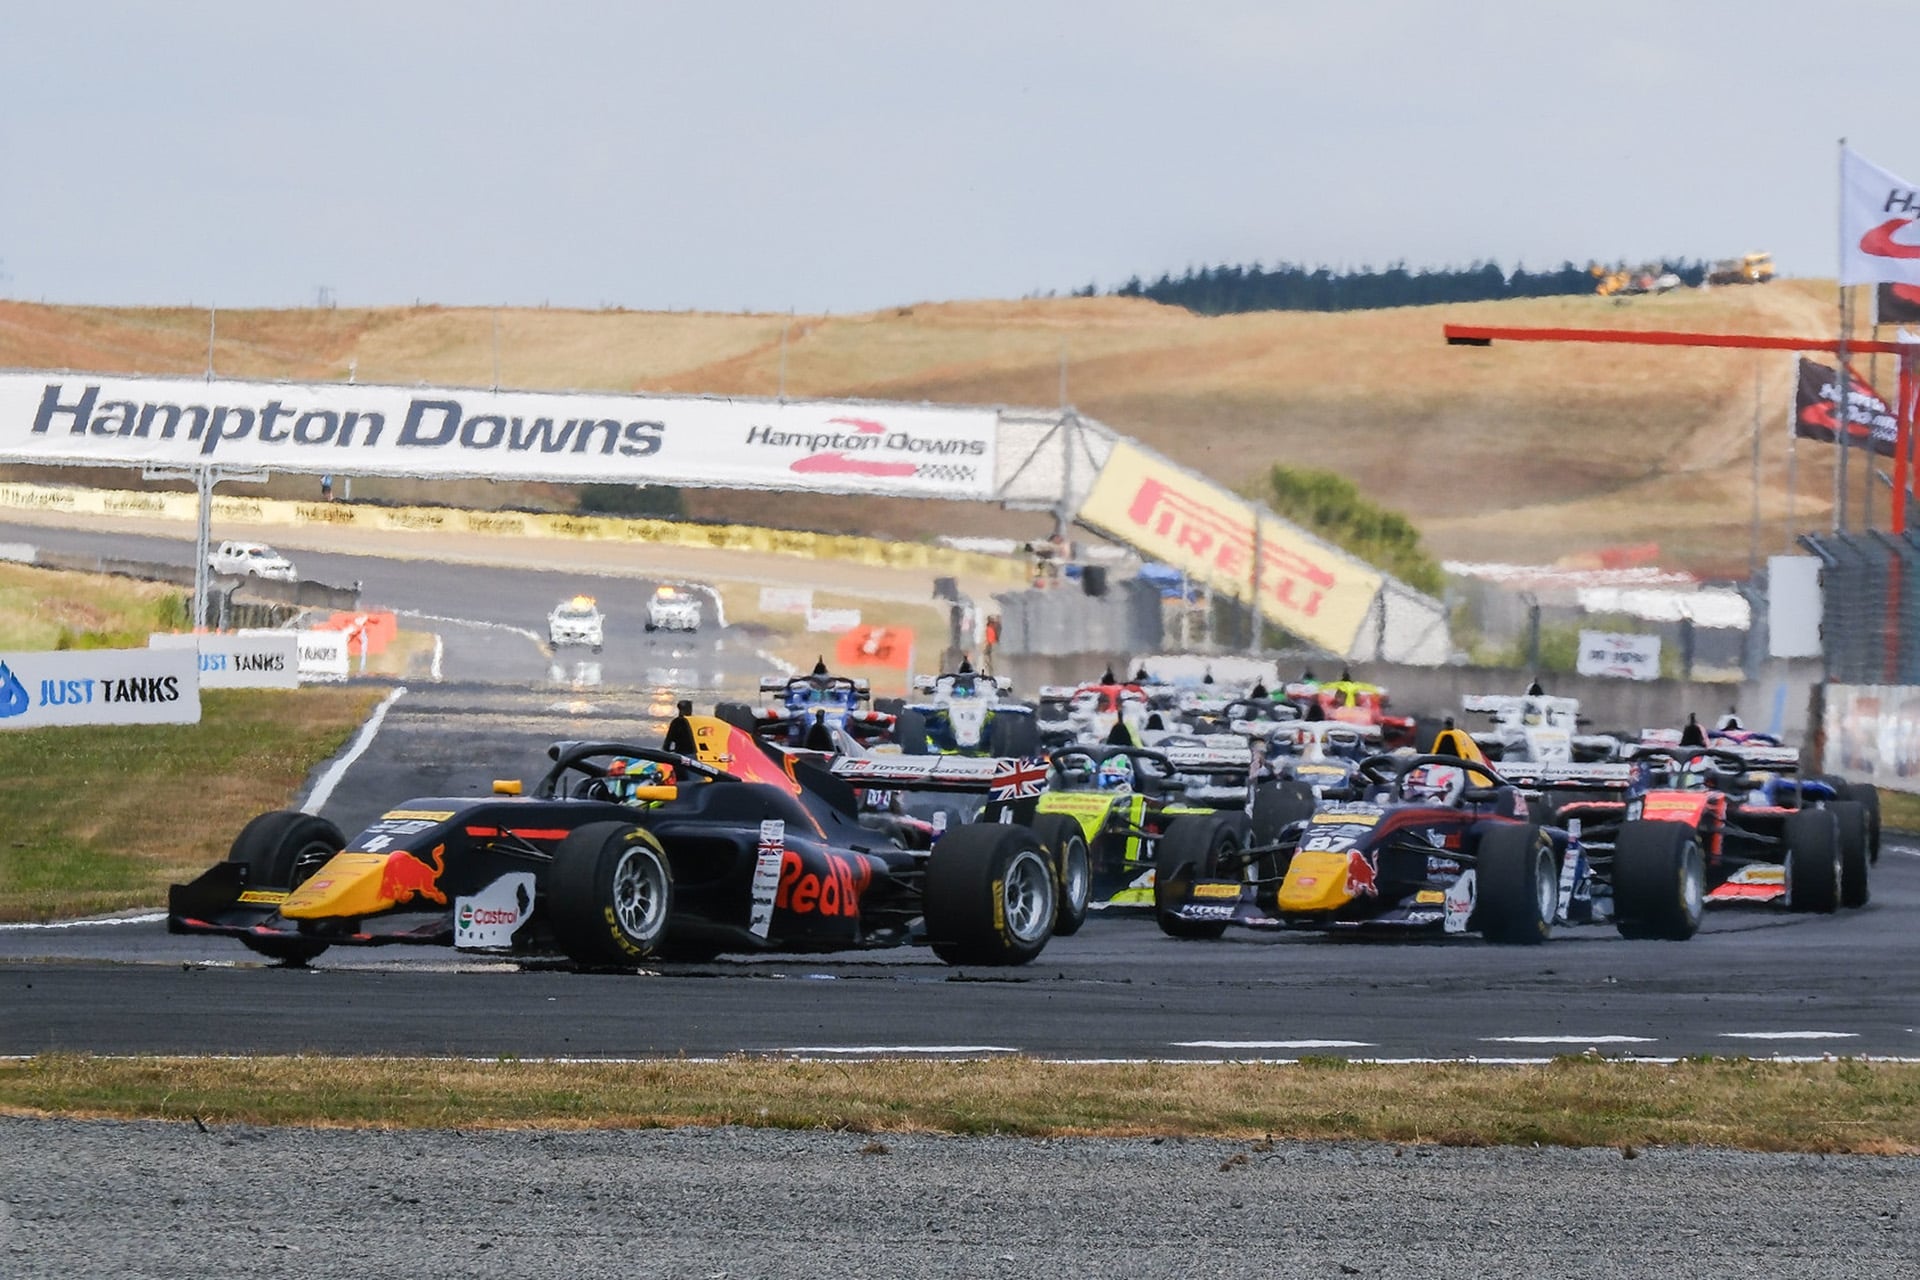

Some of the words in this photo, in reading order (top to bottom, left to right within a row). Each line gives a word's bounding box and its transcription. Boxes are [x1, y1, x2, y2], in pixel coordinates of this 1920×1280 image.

[31, 384, 385, 455] Hampton
[396, 399, 665, 457] Downs
[746, 426, 879, 451] Hampton
[886, 432, 986, 455] Downs
[198, 653, 227, 671] UST
[233, 653, 285, 671] TANKS
[40, 679, 94, 706] JUST
[101, 676, 179, 702] TANKS
[871, 764, 925, 773] TOYOTA
[361, 834, 395, 853] 4
[1304, 836, 1357, 853] 87
[473, 907, 519, 925] Castrol
